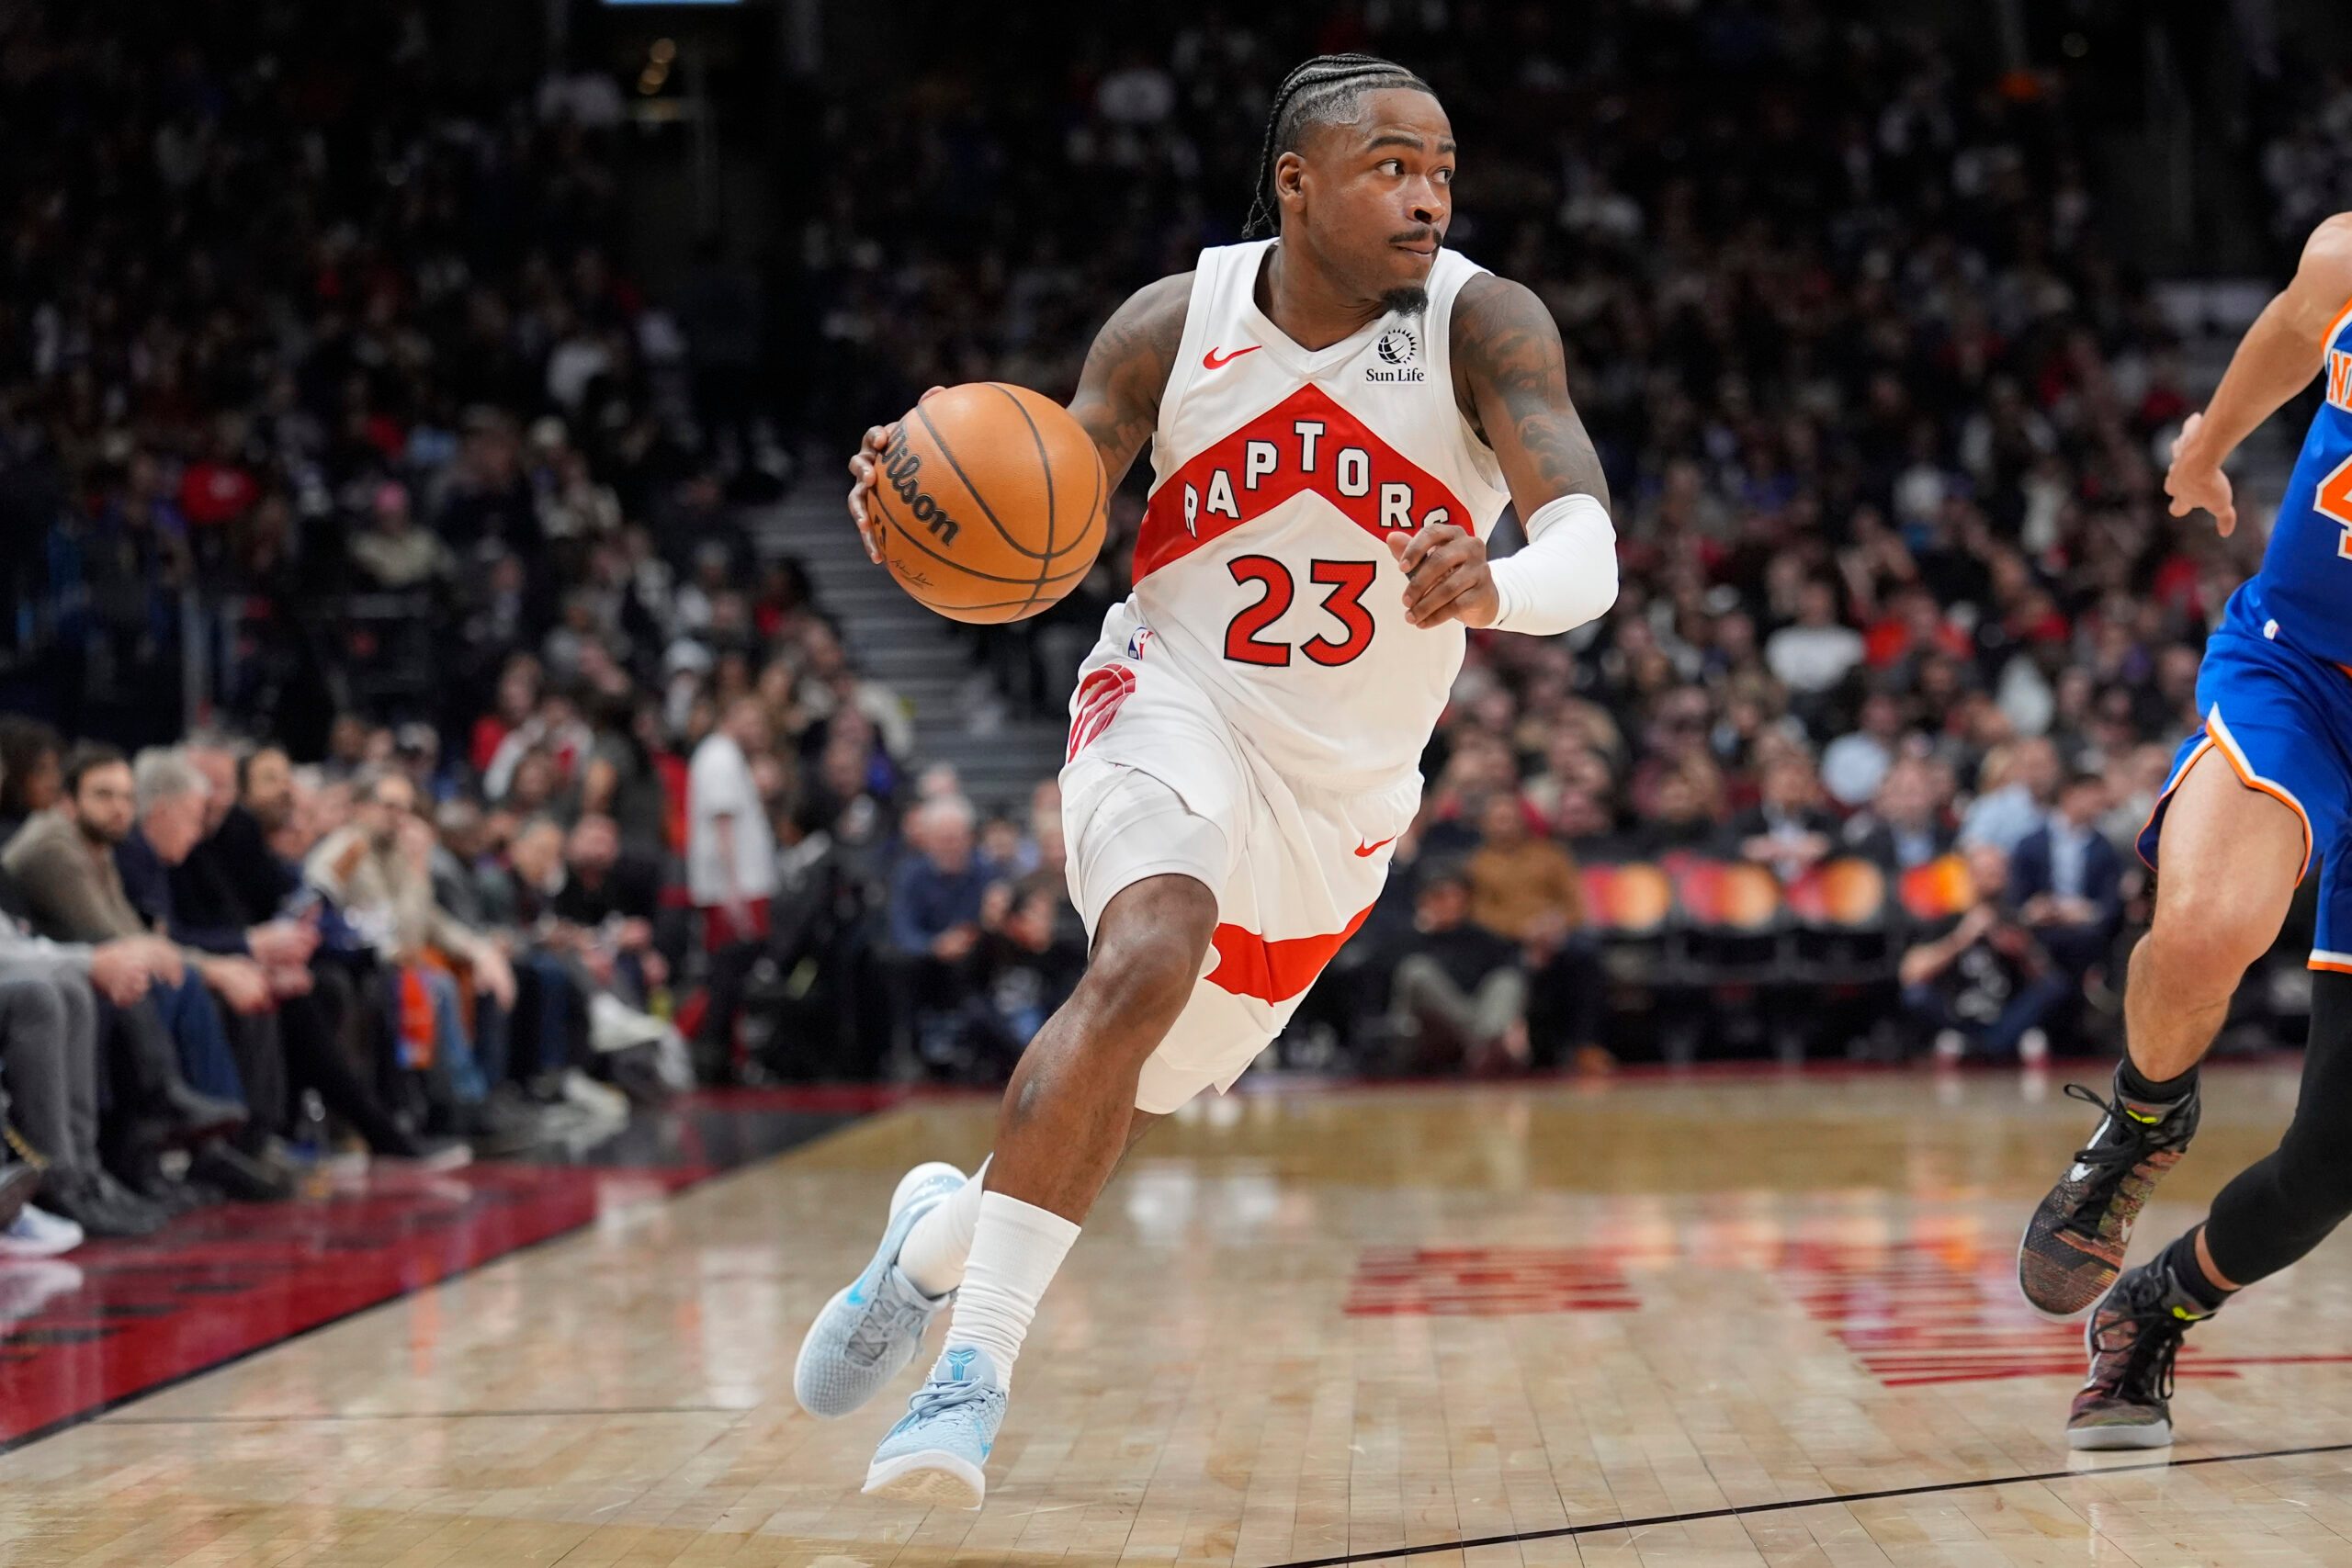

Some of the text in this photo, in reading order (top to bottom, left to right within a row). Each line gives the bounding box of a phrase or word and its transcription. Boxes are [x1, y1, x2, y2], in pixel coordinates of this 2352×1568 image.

[1366, 367, 1425, 382] Sun Life
[2326, 348, 2352, 413] N
[1224, 554, 1376, 666] 23
